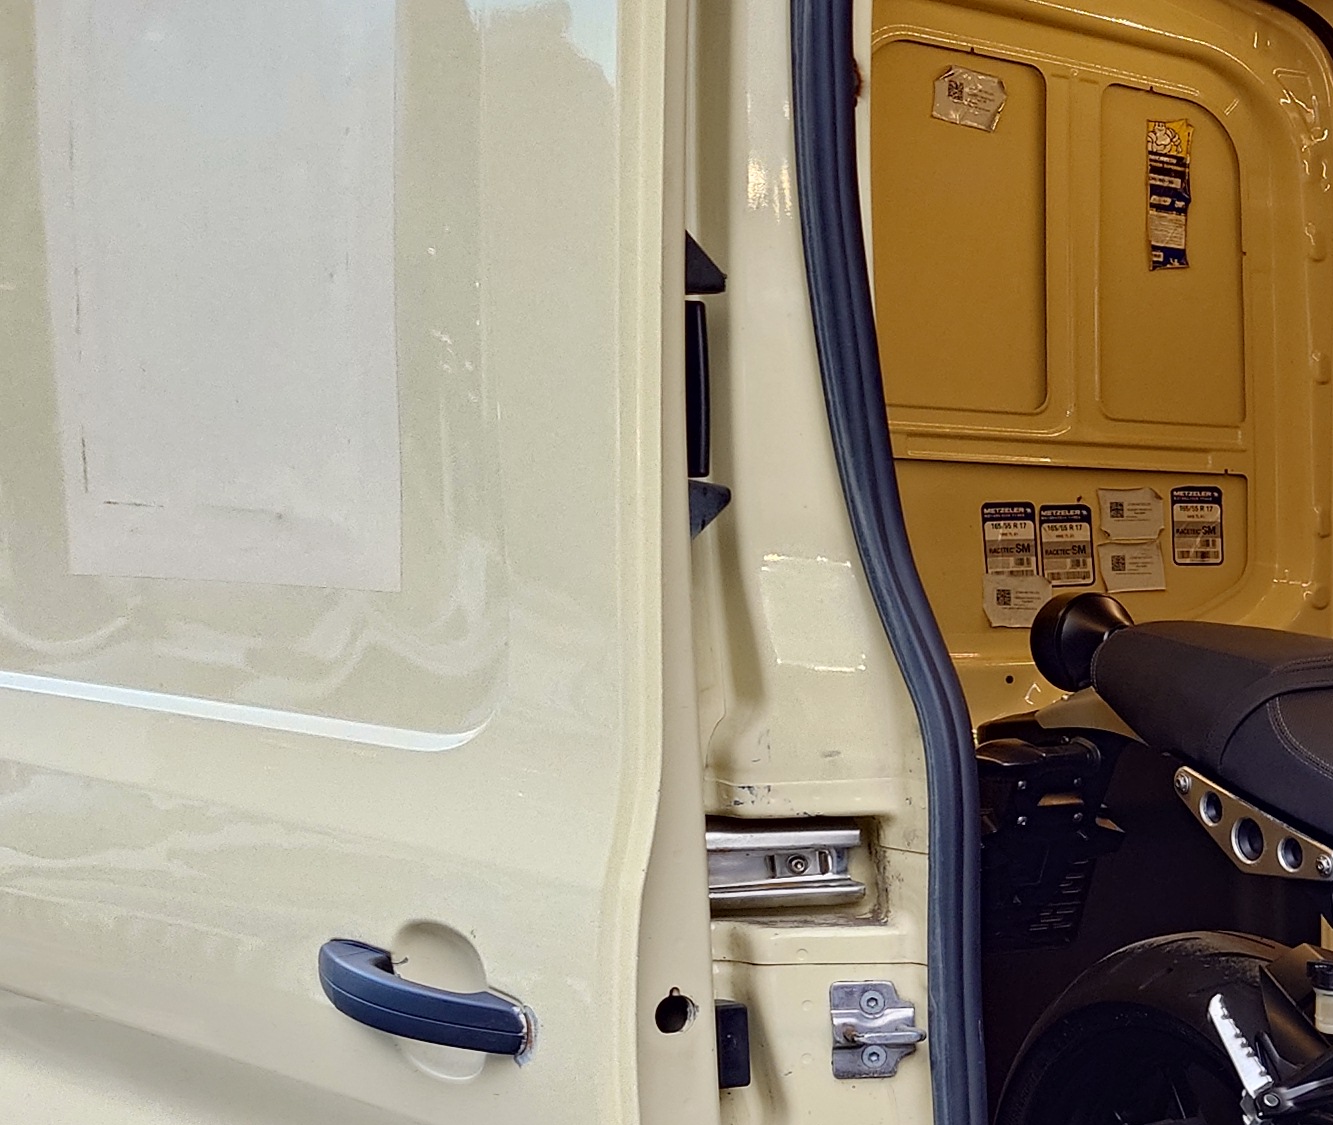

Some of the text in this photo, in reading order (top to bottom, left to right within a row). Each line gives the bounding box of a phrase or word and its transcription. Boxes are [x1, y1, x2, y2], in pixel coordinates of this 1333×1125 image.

[1202, 525, 1217, 535] SM
[1015, 543, 1031, 554] SM
[1071, 544, 1087, 555] SM
